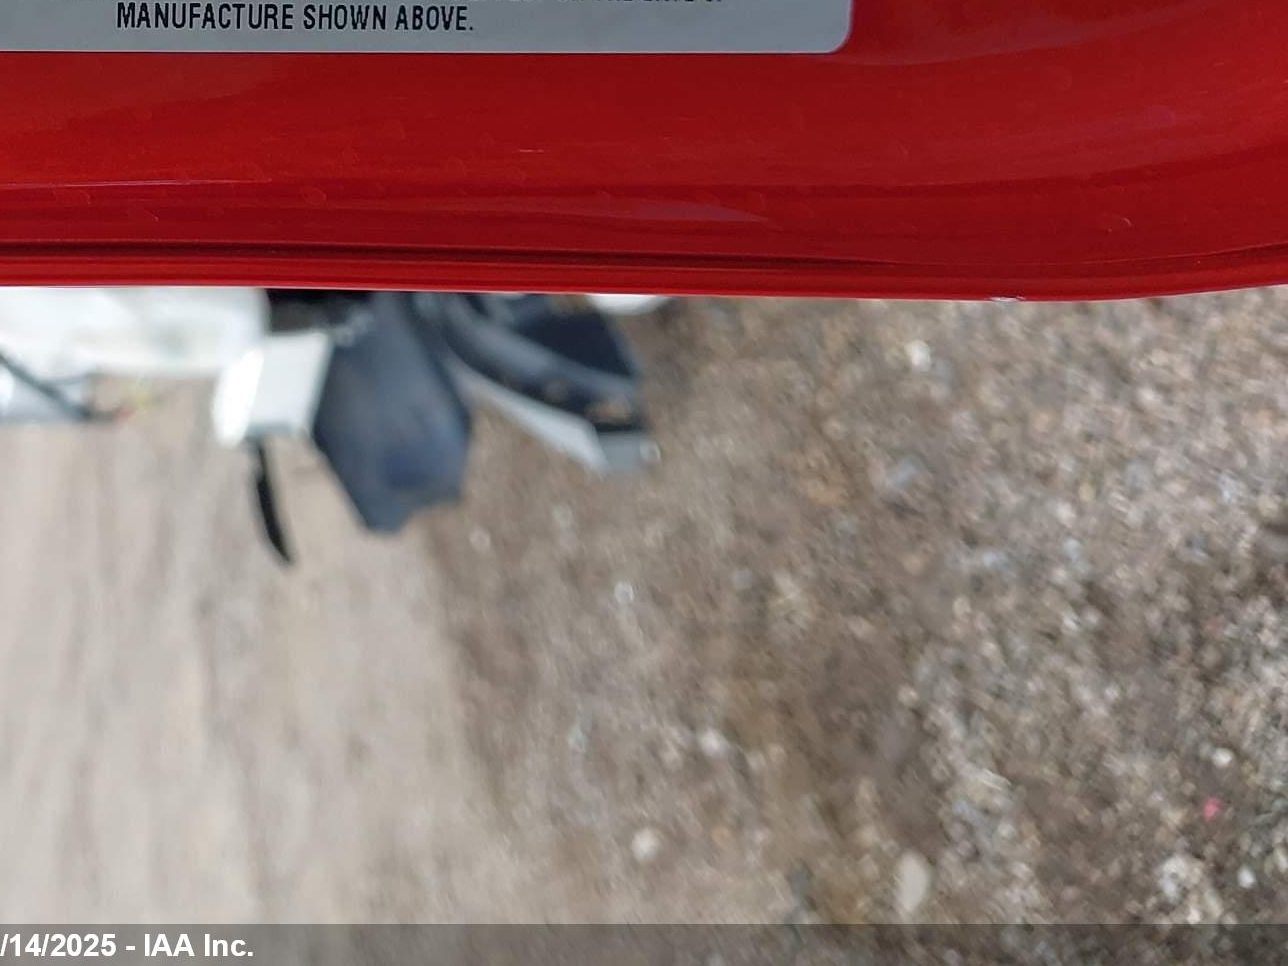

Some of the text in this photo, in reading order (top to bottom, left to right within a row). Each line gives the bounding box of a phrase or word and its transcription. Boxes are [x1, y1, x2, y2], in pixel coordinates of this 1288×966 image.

[117, 1, 474, 31] MANUFACTURE SHOWN ABOVE.
